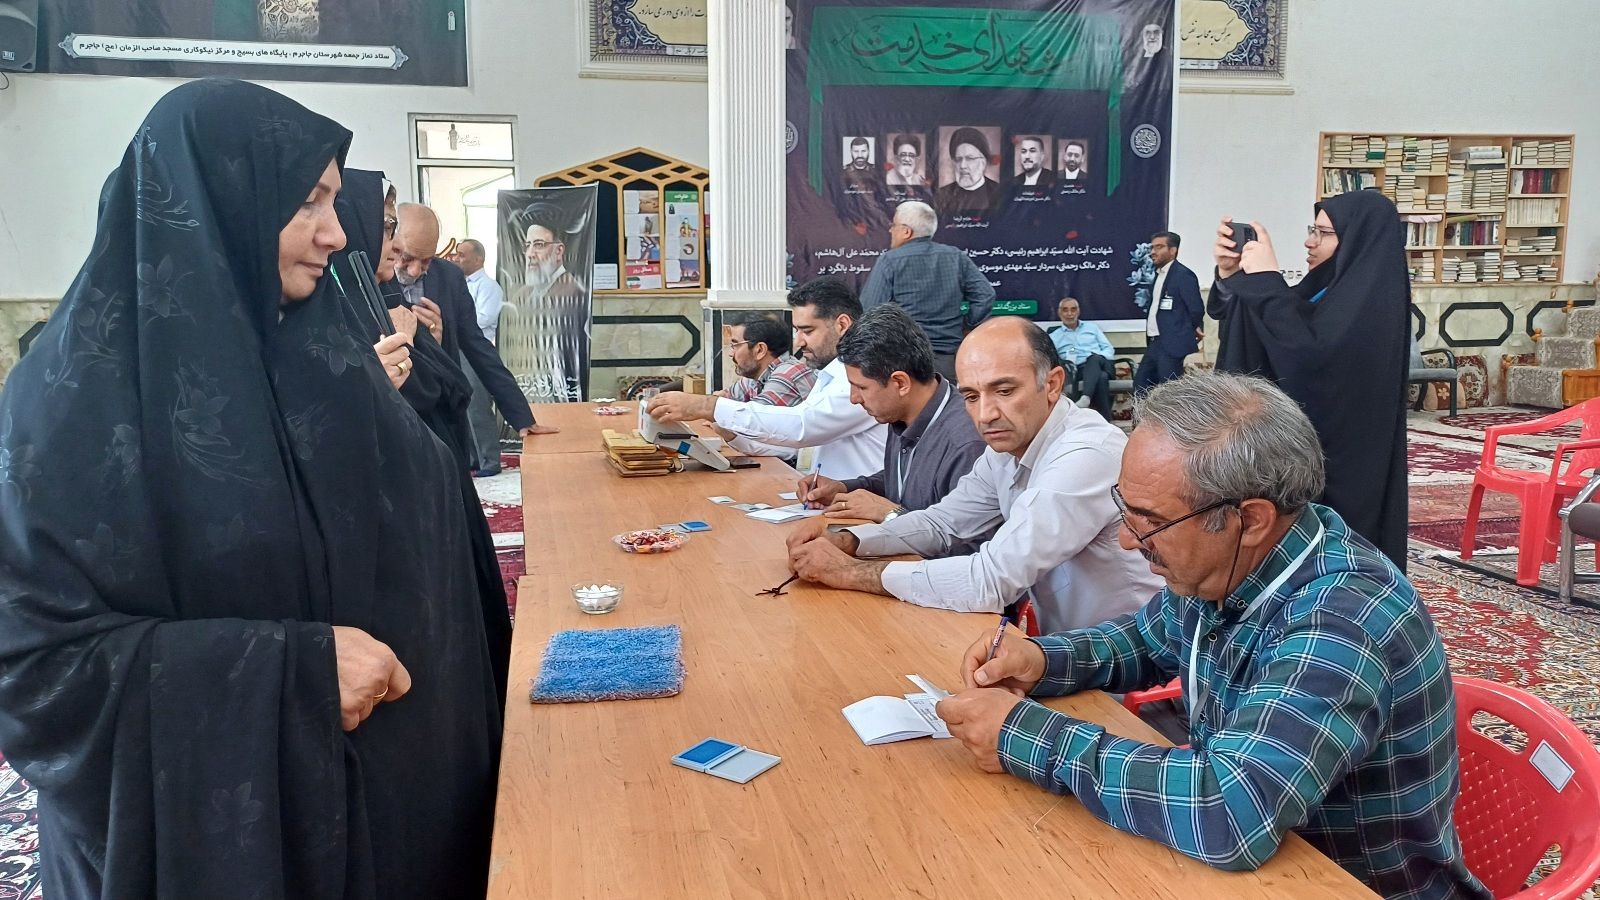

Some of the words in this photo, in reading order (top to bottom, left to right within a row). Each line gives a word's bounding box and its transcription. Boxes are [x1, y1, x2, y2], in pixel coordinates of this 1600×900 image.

[79, 42, 100, 50] جاجرم
[850, 22, 972, 67] خدمت
[183, 46, 214, 55] نیکوکاری
[215, 47, 230, 55] مرکز
[236, 49, 254, 57] بسیج
[255, 49, 269, 57] های
[269, 48, 288, 58] پایگاه
[292, 50, 312, 58] جاجرم
[361, 52, 373, 60] نماز
[845, 248, 859, 258] علی
[968, 249, 989, 257] حسین
[988, 246, 1004, 257] دکتر
[1026, 246, 1049, 257] ابراهیم
[1063, 244, 1075, 254] الله
[1075, 244, 1090, 256] آیت
[1089, 246, 1114, 256] شهادت
[828, 262, 848, 274] بالگرد
[848, 264, 871, 274] سقوط
[979, 264, 1003, 273] موسوی
[1003, 263, 1023, 272] مهدی
[1036, 262, 1055, 272] سردار
[1078, 260, 1095, 269] مالک
[1095, 260, 1110, 271] دکتر
[1017, 302, 1031, 310] ستاد
